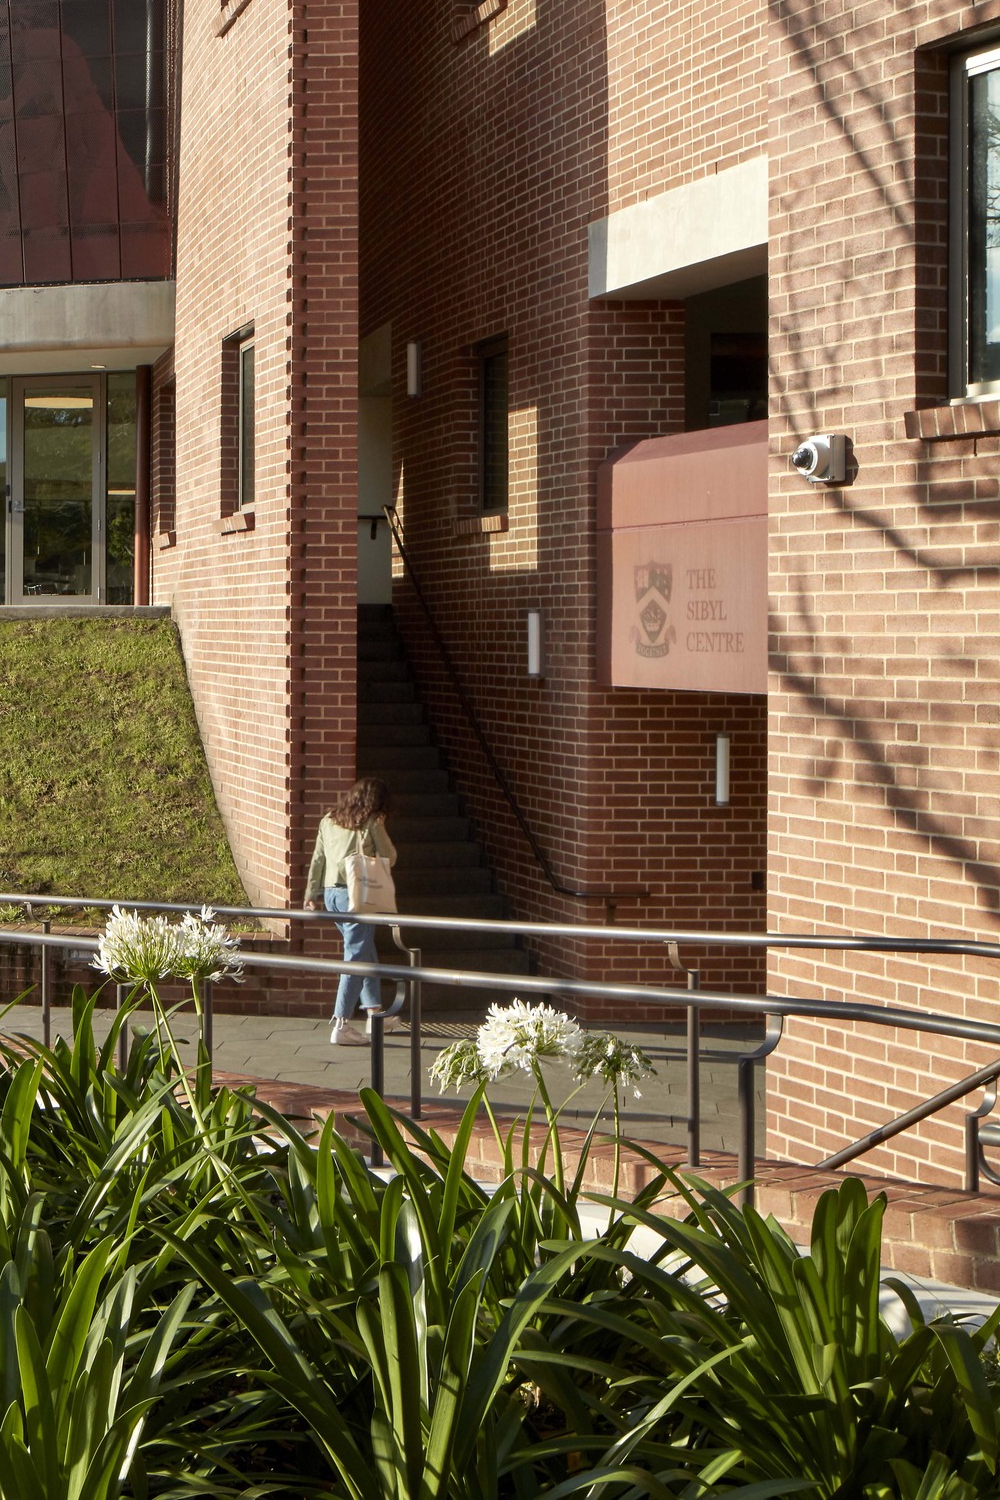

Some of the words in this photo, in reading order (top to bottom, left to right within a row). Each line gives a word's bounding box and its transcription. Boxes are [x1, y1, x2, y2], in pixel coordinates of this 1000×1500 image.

[686, 568, 716, 589] THE
[686, 600, 727, 621] SIBYL
[686, 632, 744, 653] CENTRE
